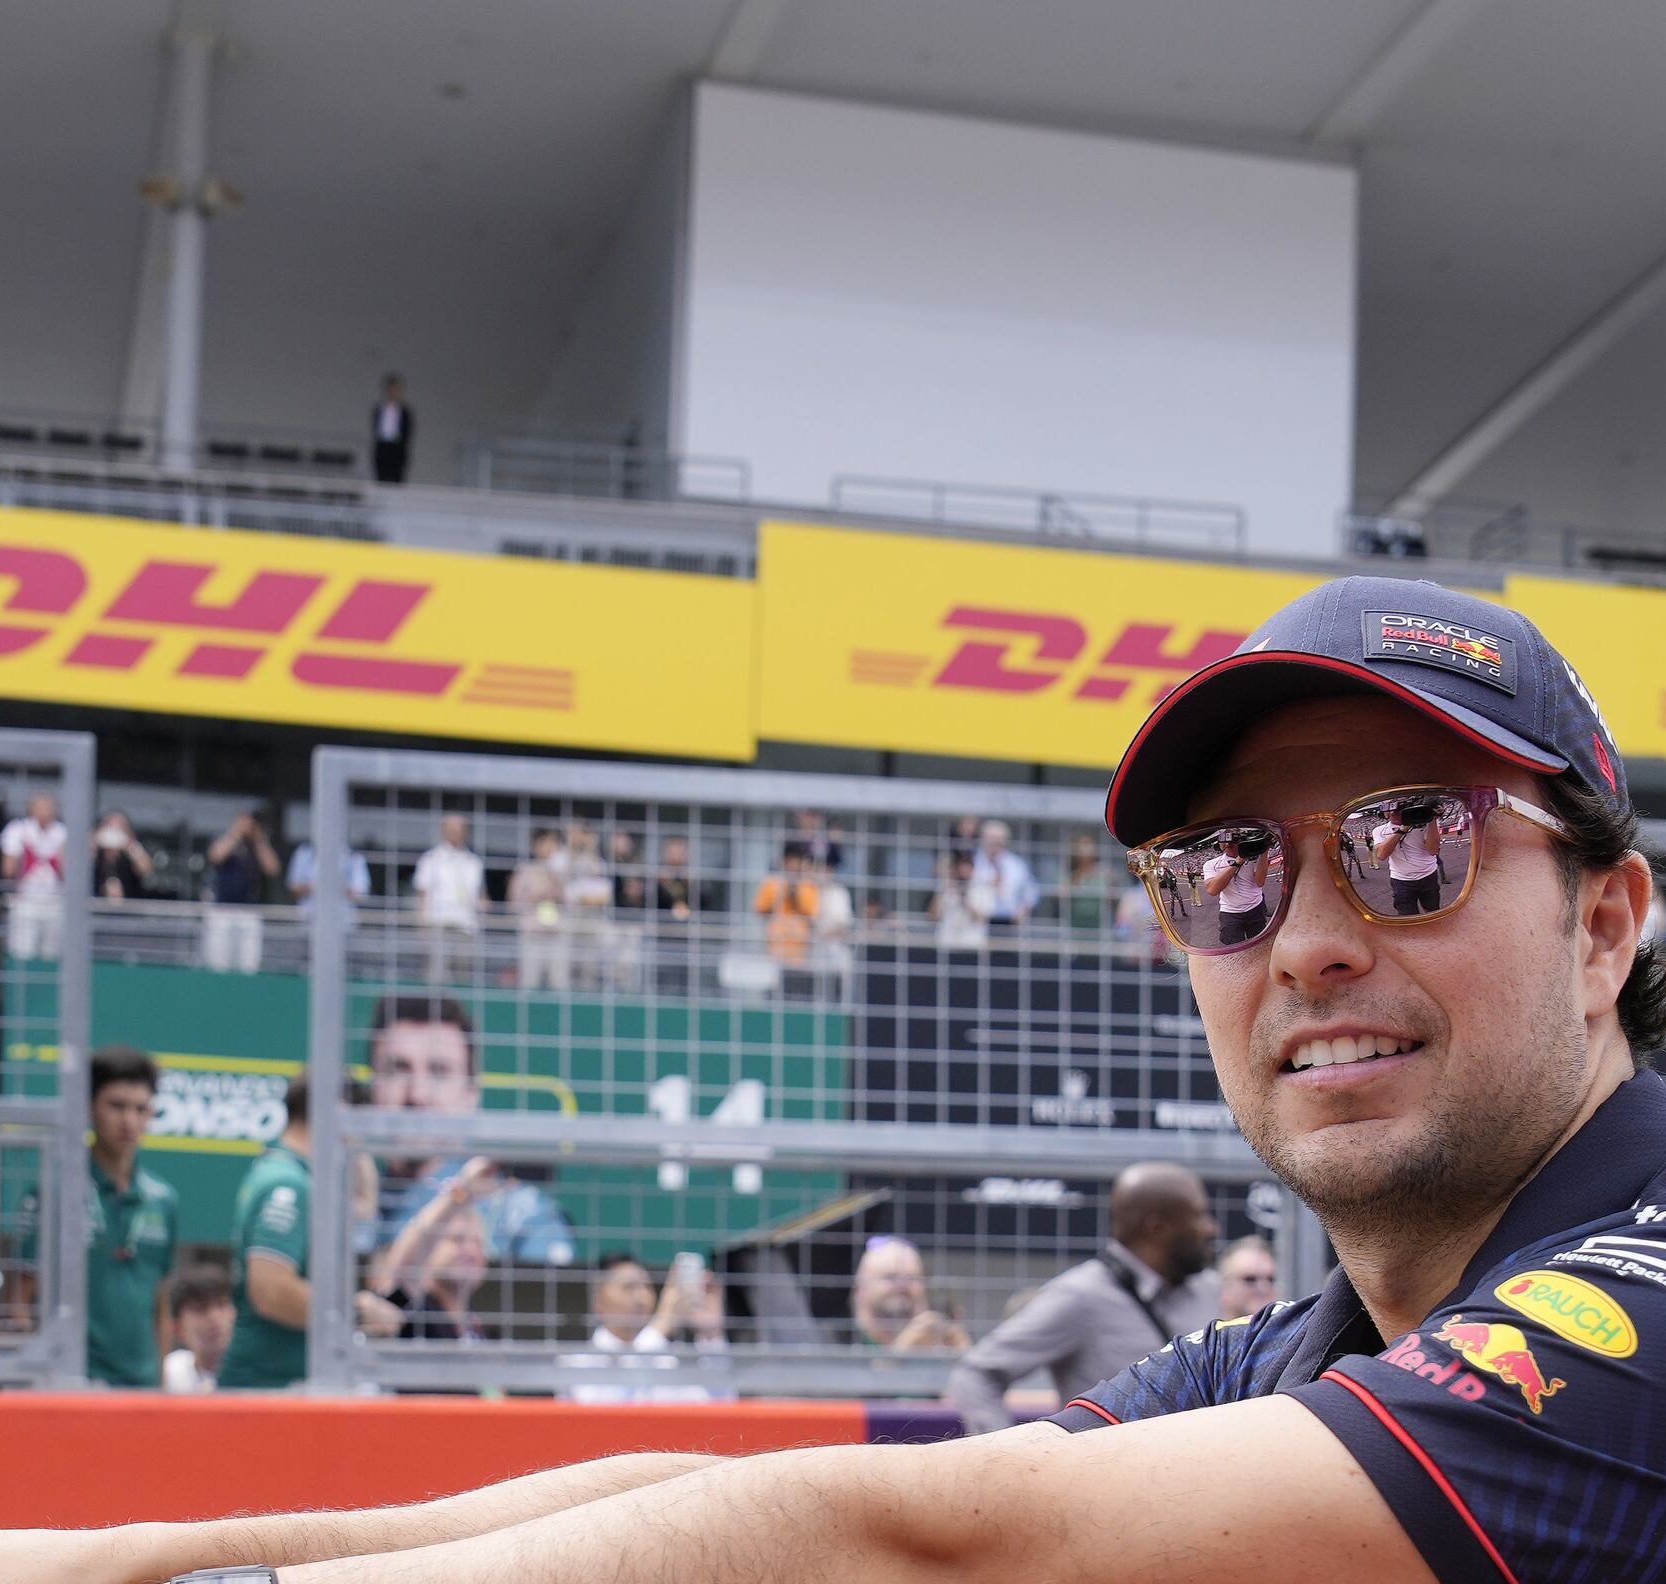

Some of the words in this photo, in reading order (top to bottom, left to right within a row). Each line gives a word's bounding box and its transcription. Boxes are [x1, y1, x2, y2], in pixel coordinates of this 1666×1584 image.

[934, 605, 1250, 706] DH
[1380, 615, 1499, 650] ORACLE
[1381, 627, 1415, 639] Red
[1416, 630, 1449, 646] Bull
[1382, 642, 1501, 677] RACING
[649, 1074, 774, 1195] 14
[1527, 1283, 1622, 1346] RAUCH
